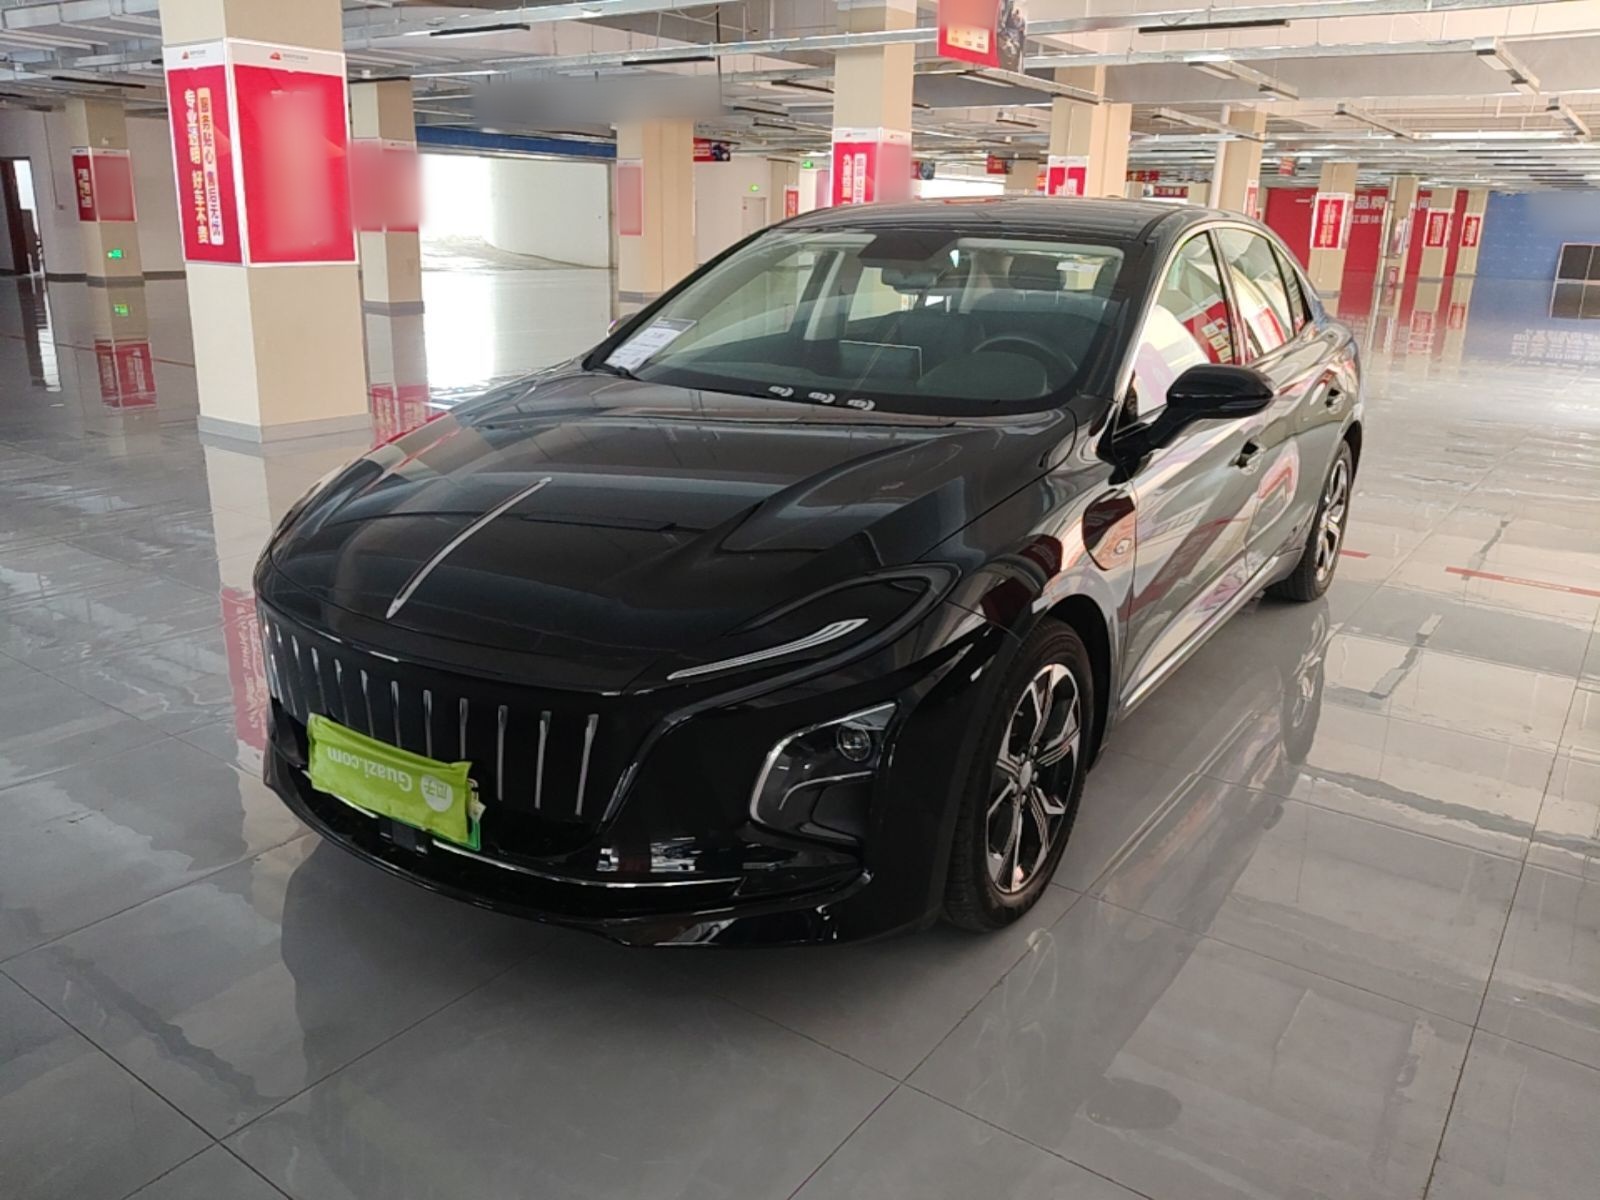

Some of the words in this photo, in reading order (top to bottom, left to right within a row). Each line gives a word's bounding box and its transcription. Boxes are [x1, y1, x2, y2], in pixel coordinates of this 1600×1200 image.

[192, 170, 209, 244] 好车不贵
[326, 746, 413, 793] Guazi.com
